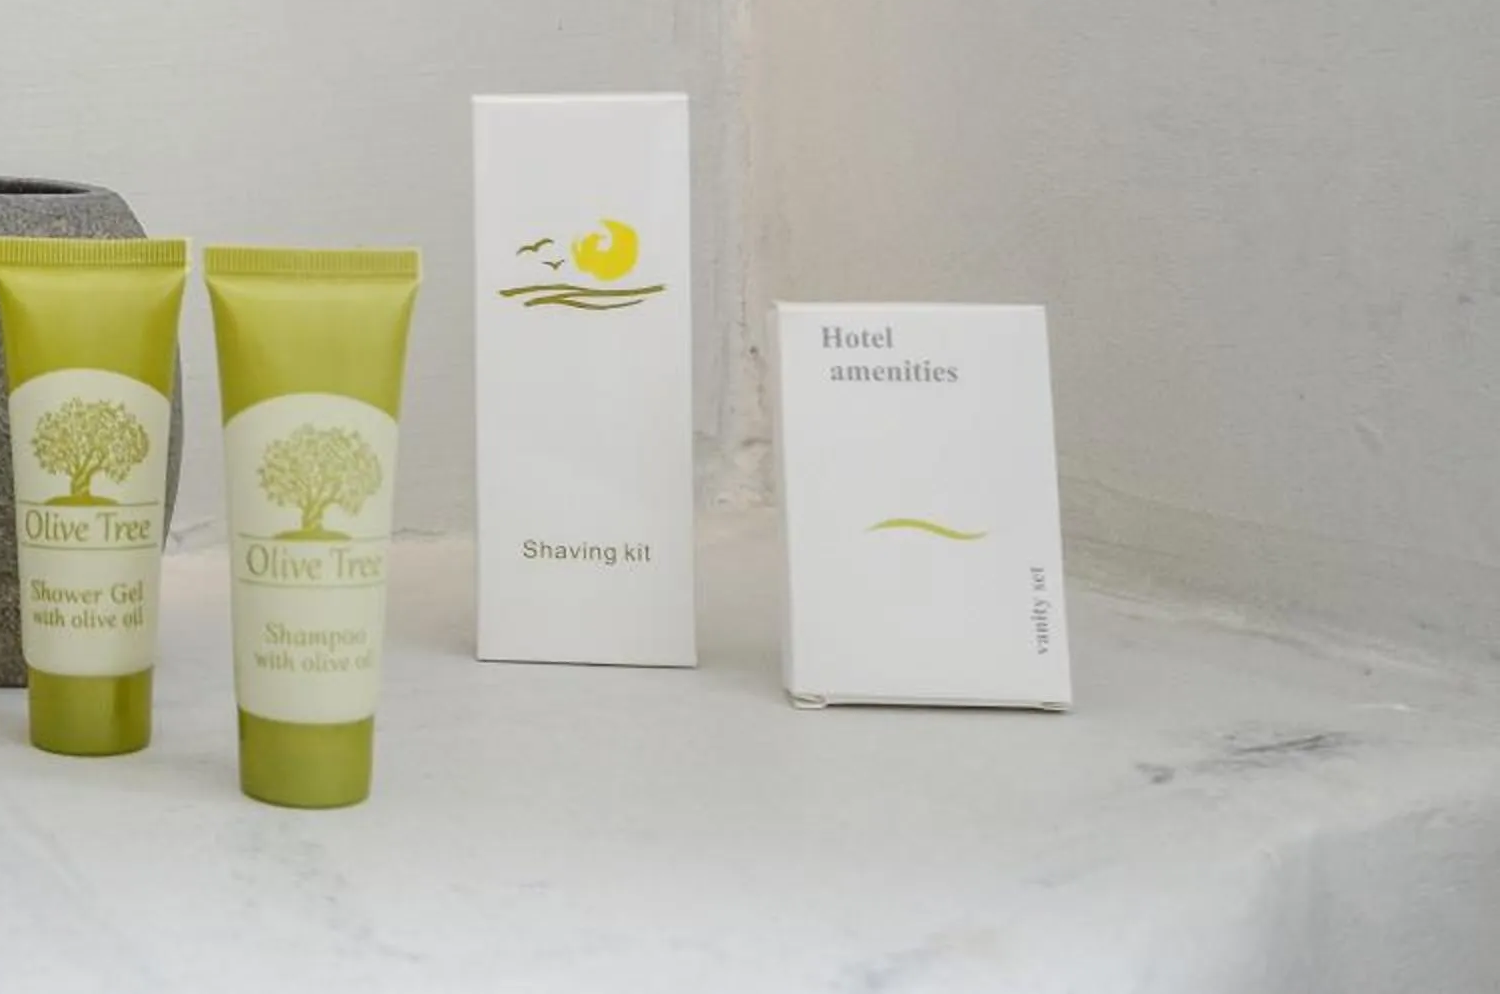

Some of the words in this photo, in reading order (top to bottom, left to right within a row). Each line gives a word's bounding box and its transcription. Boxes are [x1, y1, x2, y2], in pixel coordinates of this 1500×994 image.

[822, 325, 893, 348] Hotel
[830, 359, 959, 382] amenities
[25, 509, 90, 542] Olive
[95, 511, 151, 542] Tree
[246, 543, 322, 581] Olive
[328, 546, 382, 579] Tree
[522, 538, 617, 566] Shaving
[624, 541, 651, 562] kit
[30, 579, 103, 604] Shower
[110, 580, 144, 606] Gel
[33, 607, 66, 627] with
[71, 608, 117, 628] olive
[122, 605, 144, 627] oil
[1029, 598, 1052, 655] vanity
[263, 621, 369, 654] Shampoo
[253, 650, 294, 671] with
[301, 651, 349, 673] olive
